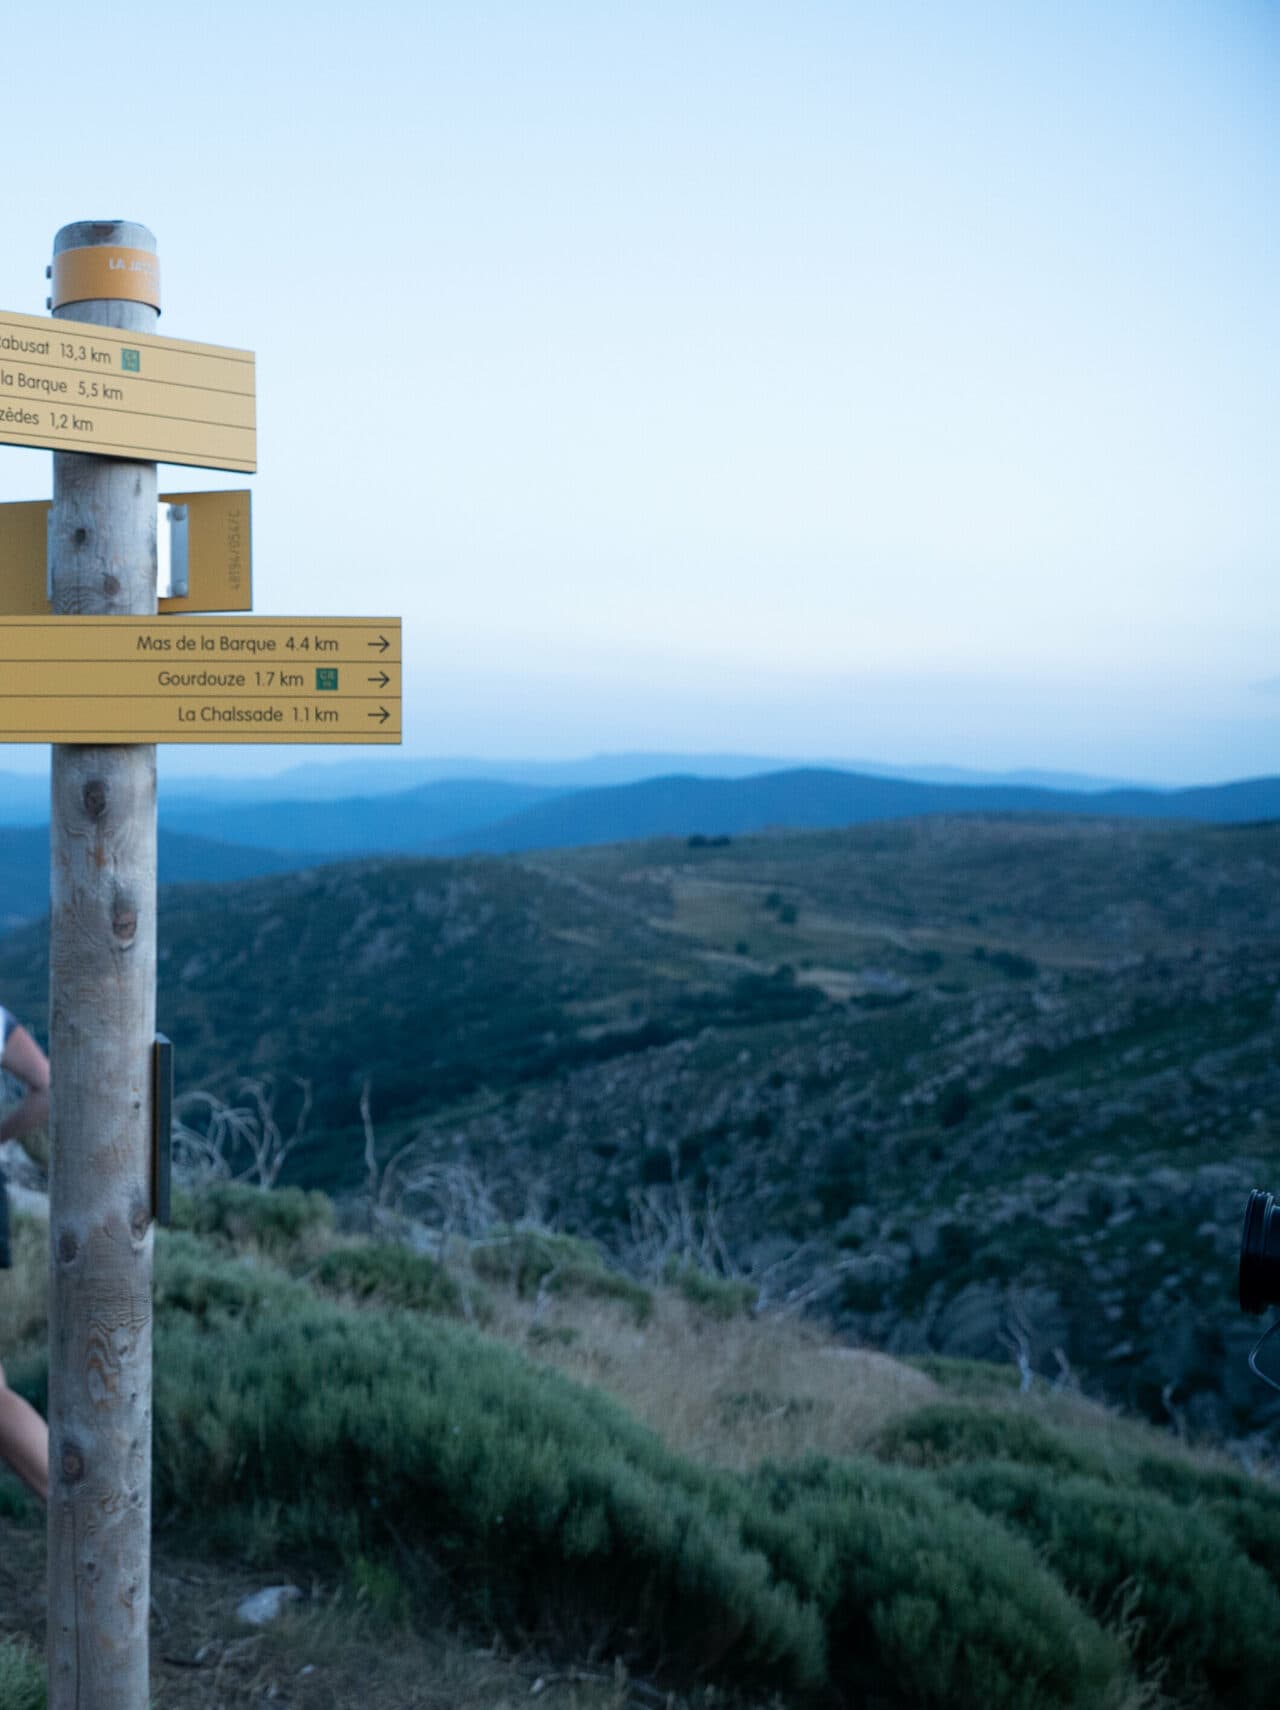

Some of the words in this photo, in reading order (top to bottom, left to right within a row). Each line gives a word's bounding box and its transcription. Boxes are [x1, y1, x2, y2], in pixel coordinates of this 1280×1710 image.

[60, 343, 87, 361] 13,3
[91, 346, 111, 364] km
[1, 369, 14, 386] la
[18, 373, 68, 394] Barque
[78, 381, 99, 398] 5,5
[102, 383, 123, 401] km
[49, 412, 69, 430] 1,2
[72, 415, 94, 432] km
[137, 635, 172, 651] Mas
[176, 635, 197, 652] de
[201, 635, 215, 652] la
[220, 635, 276, 654] Barque
[315, 635, 339, 652] km
[158, 671, 245, 688] Gourdouze
[280, 671, 304, 688] km
[178, 706, 196, 722] La
[315, 706, 339, 722] km
